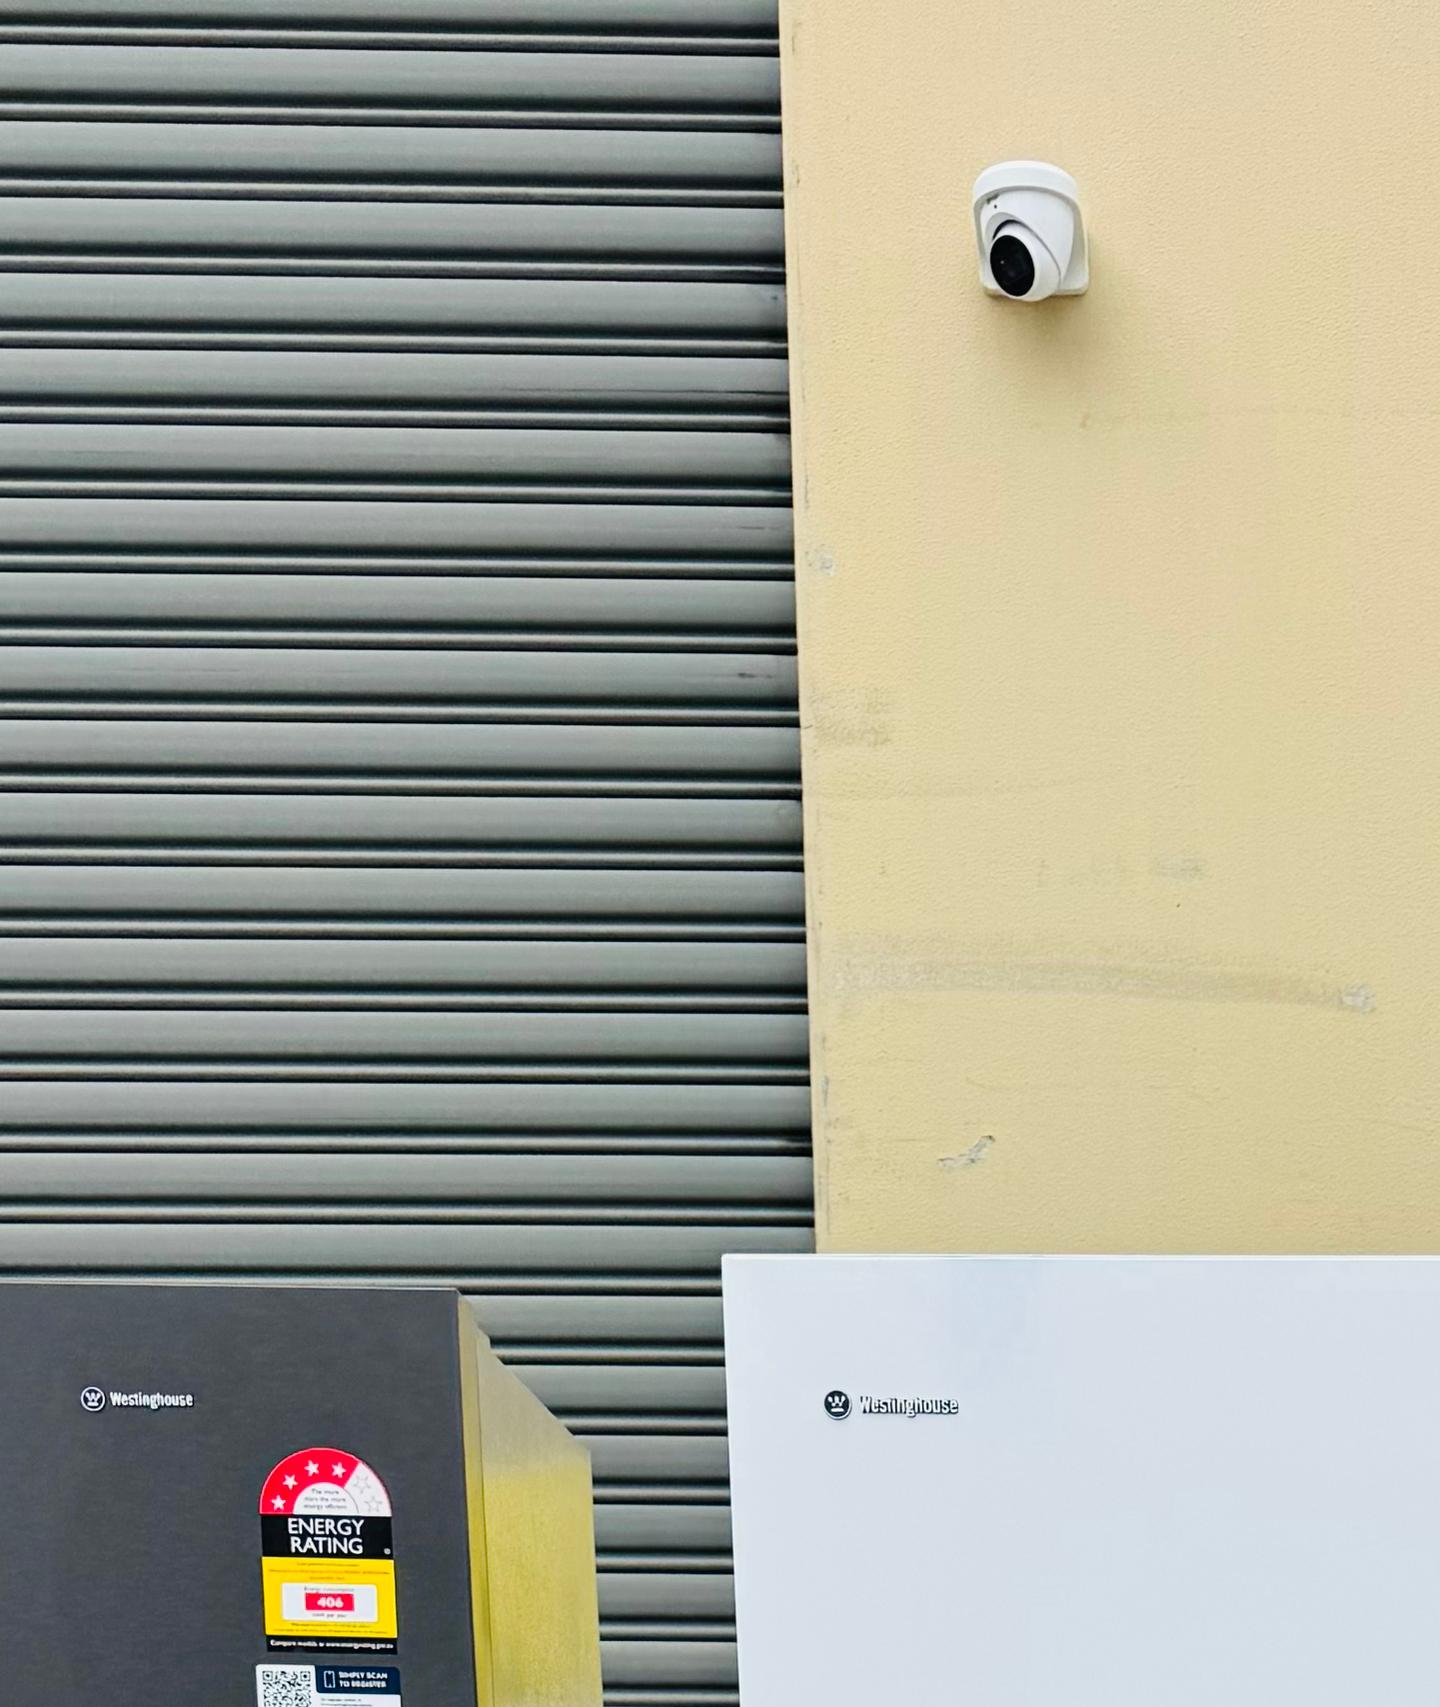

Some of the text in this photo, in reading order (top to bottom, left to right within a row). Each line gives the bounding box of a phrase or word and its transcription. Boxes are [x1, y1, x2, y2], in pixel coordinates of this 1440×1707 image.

[109, 1391, 193, 1409] Westinghouse
[859, 1396, 959, 1418] Westinghouse
[287, 1517, 364, 1535] ENERGY
[290, 1536, 363, 1554] RATING
[317, 1596, 344, 1608] 406
